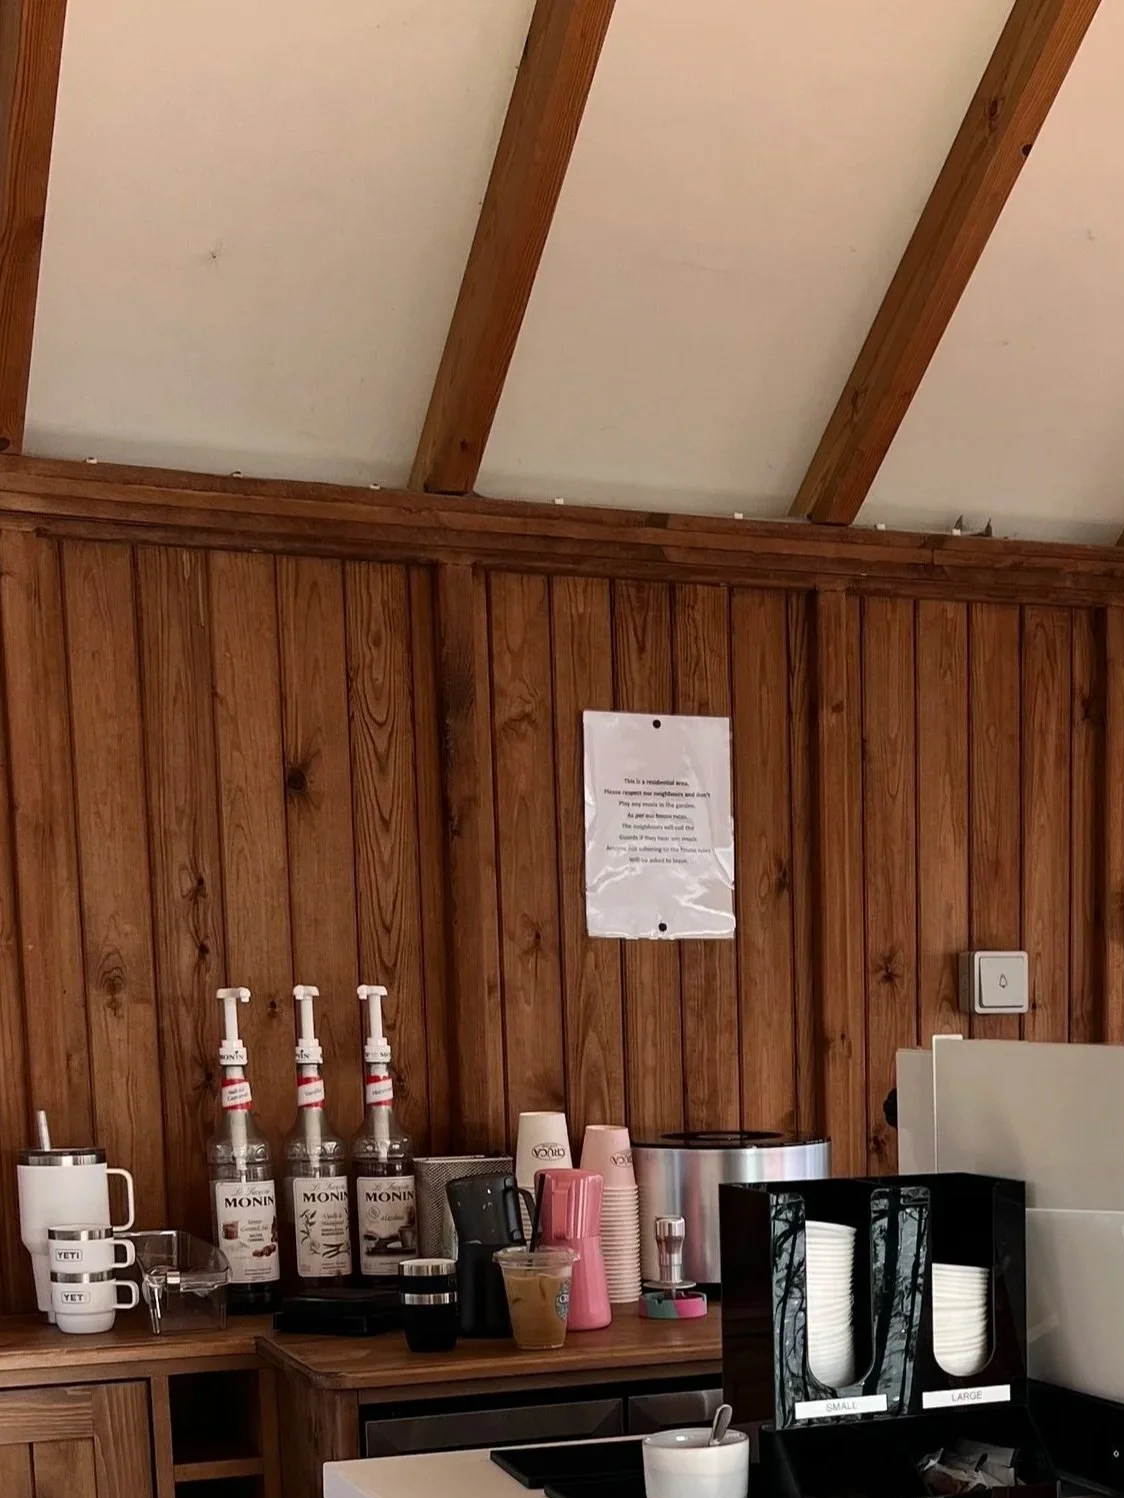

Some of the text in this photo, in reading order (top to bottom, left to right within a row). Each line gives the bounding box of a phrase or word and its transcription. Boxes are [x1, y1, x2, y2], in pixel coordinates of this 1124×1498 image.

[224, 1195, 274, 1209] MONIN
[366, 1190, 414, 1203] MONIN
[57, 1251, 80, 1260] YETI
[951, 1391, 983, 1402] LARGE
[826, 1400, 858, 1413] SMALL
